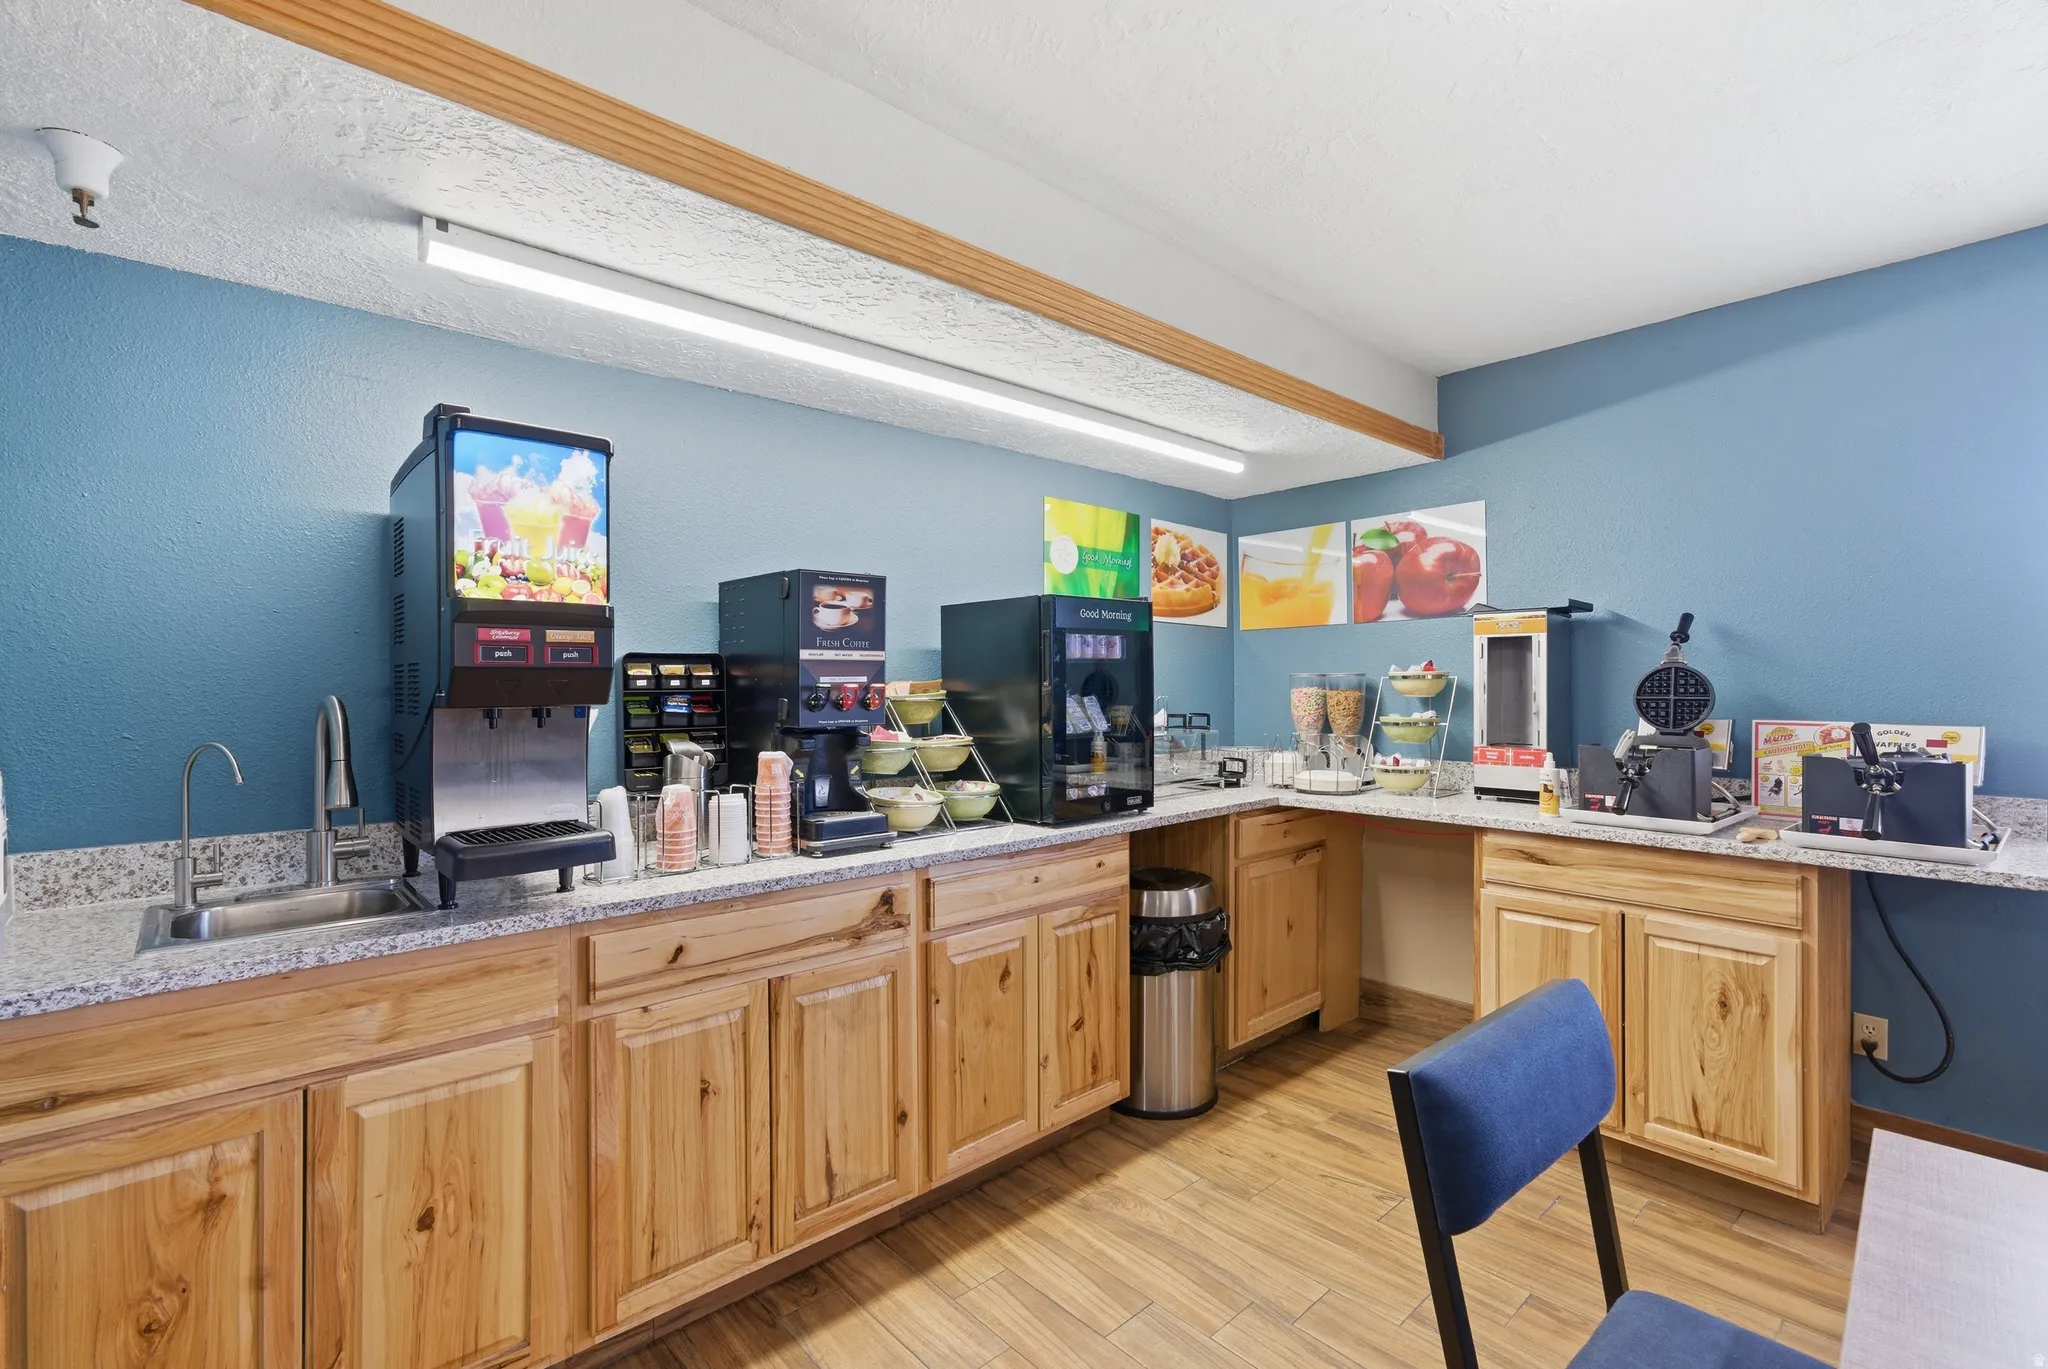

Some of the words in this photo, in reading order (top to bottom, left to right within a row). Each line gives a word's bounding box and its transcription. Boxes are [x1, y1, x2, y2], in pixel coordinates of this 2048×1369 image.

[541, 535, 598, 565] Juice
[1082, 550, 1099, 565] Good
[1080, 608, 1099, 618] Good
[1101, 610, 1132, 622] Morning
[816, 636, 840, 647] FRESH
[842, 637, 870, 648] COFFEE
[563, 651, 579, 659] push
[1876, 729, 1911, 738] GOLDEN
